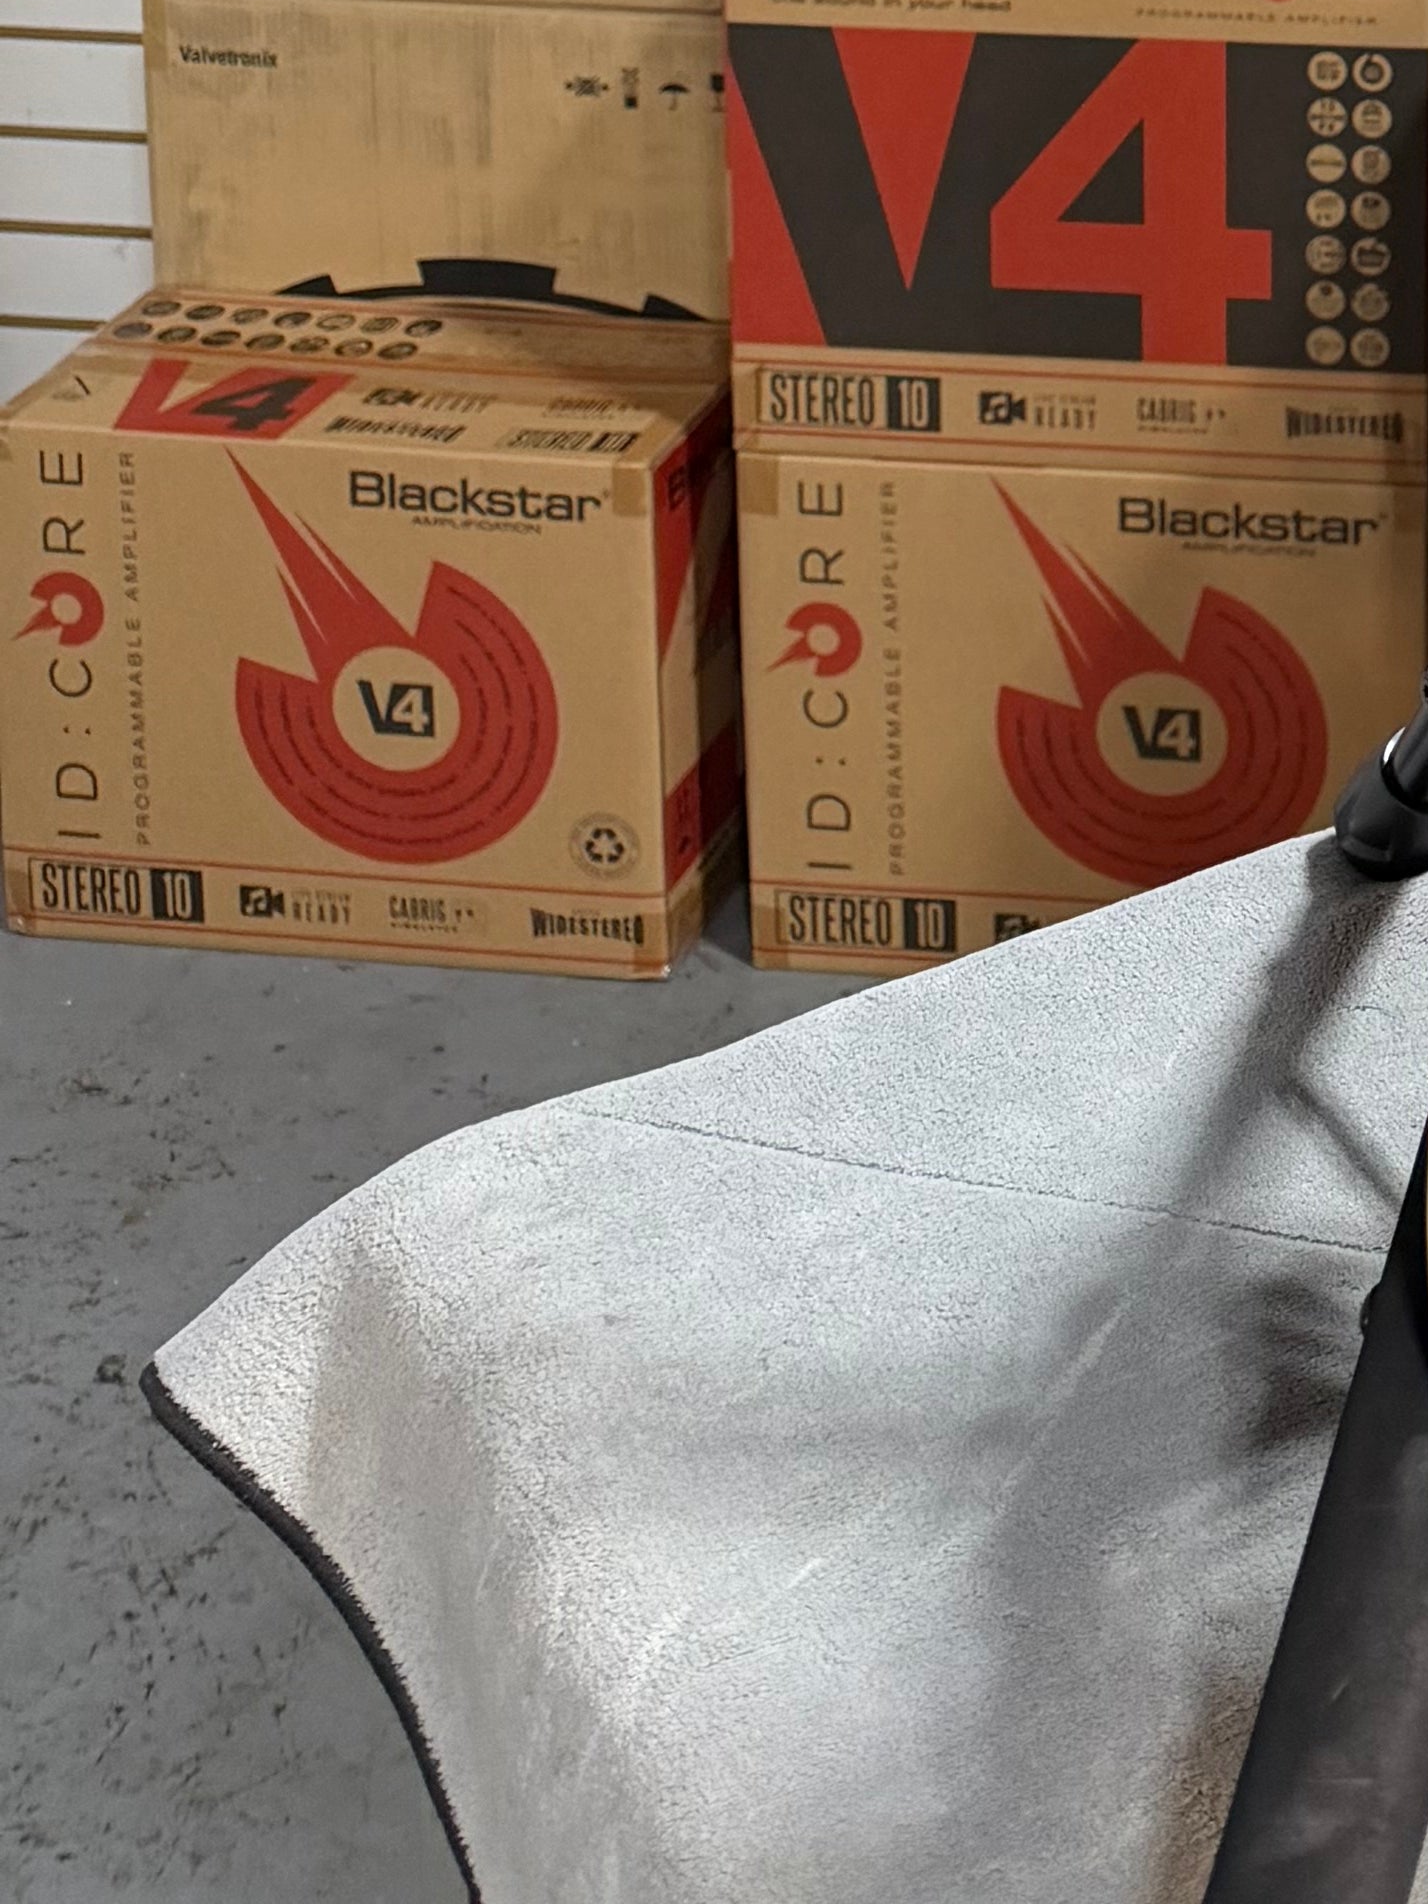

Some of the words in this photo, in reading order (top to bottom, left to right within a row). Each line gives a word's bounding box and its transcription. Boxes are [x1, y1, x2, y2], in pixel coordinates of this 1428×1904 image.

[179, 43, 279, 69] Valvetronix
[728, 24, 1272, 367] V4
[113, 357, 357, 440] V4
[770, 373, 876, 427] STEREO
[896, 379, 930, 430] 10
[349, 470, 602, 523] Blackstar
[412, 514, 542, 535] AMPLIFICATION
[1118, 496, 1379, 546] Blackstar
[118, 451, 140, 602] AMPLIFIER
[878, 481, 900, 632] AMPLIFIER
[125, 618, 152, 846] PROGRAMMABLE
[358, 679, 434, 737] V4
[1122, 705, 1201, 764] V4
[882, 647, 907, 877] PROGRAMMABLE
[40, 861, 141, 915] STEREO
[162, 871, 194, 920] 10
[529, 906, 645, 948] WIDESTEREO
[787, 895, 894, 947] STEREO
[913, 904, 947, 950] 10
